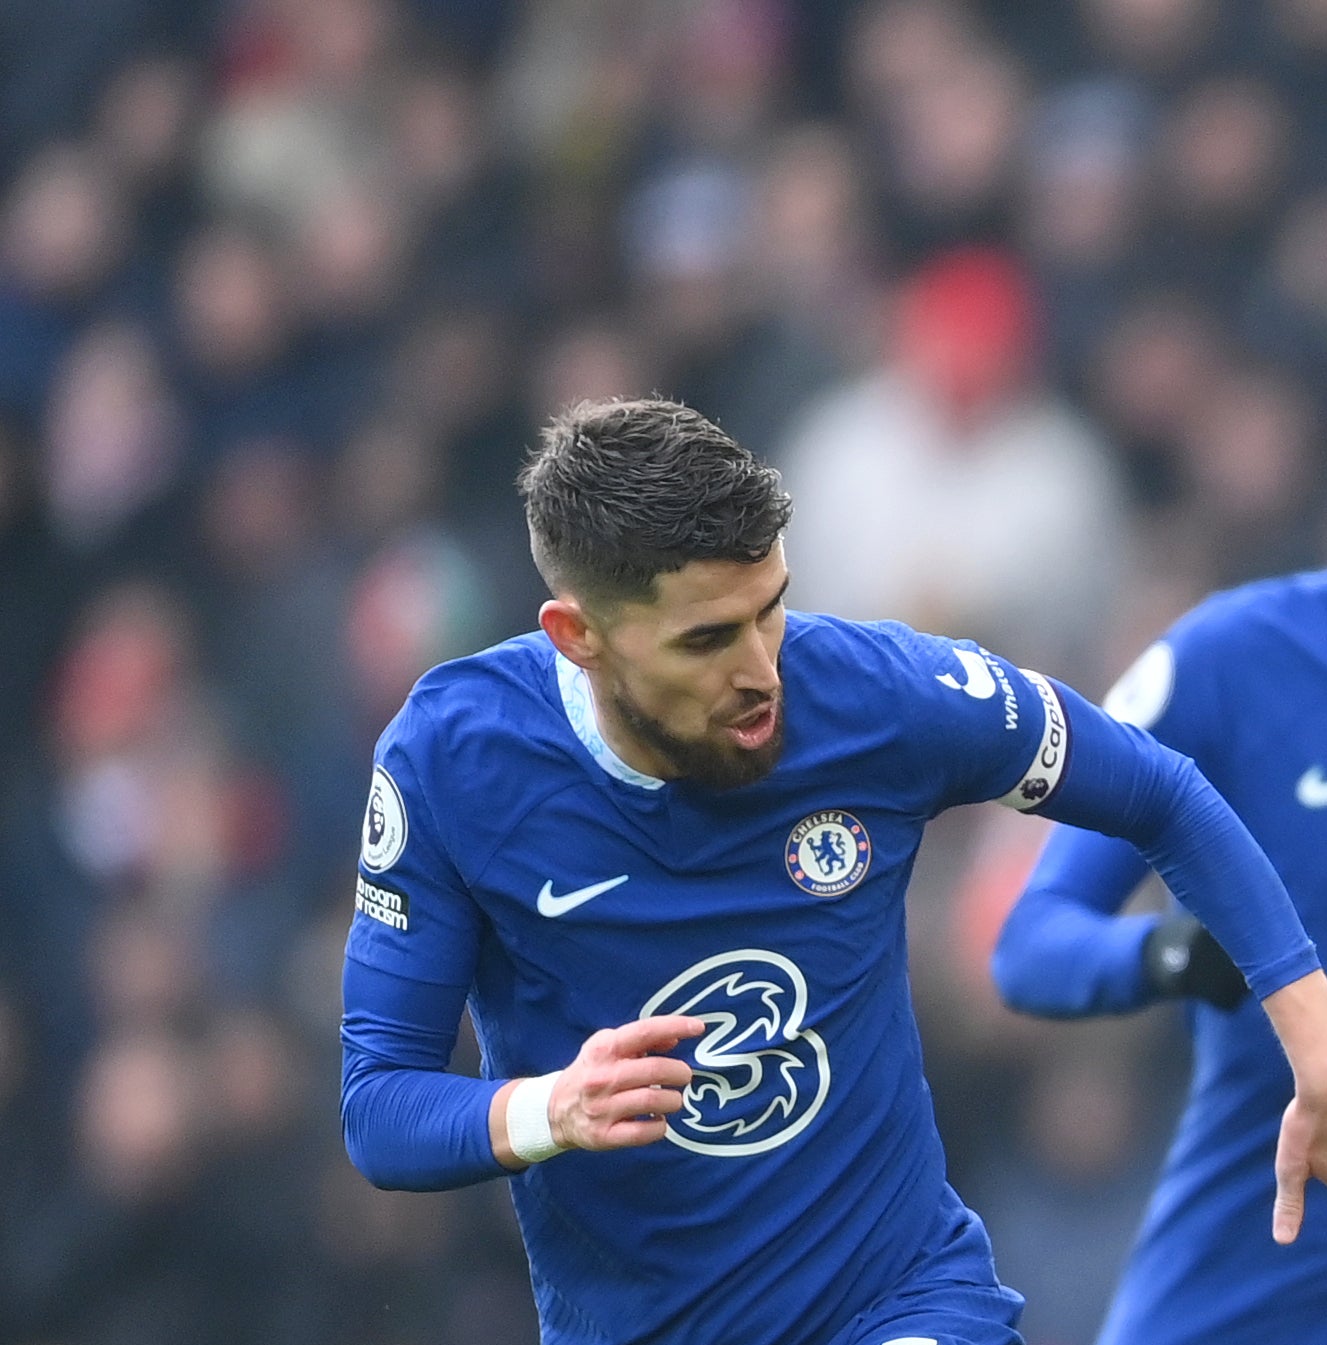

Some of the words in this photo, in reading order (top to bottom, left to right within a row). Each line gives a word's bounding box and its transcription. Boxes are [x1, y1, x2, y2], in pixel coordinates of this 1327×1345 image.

[792, 812, 843, 843] CHELSEA
[364, 883, 402, 912] room
[811, 880, 850, 893] FOOTBALL
[364, 899, 408, 931] racism
[639, 948, 831, 1157] 3
